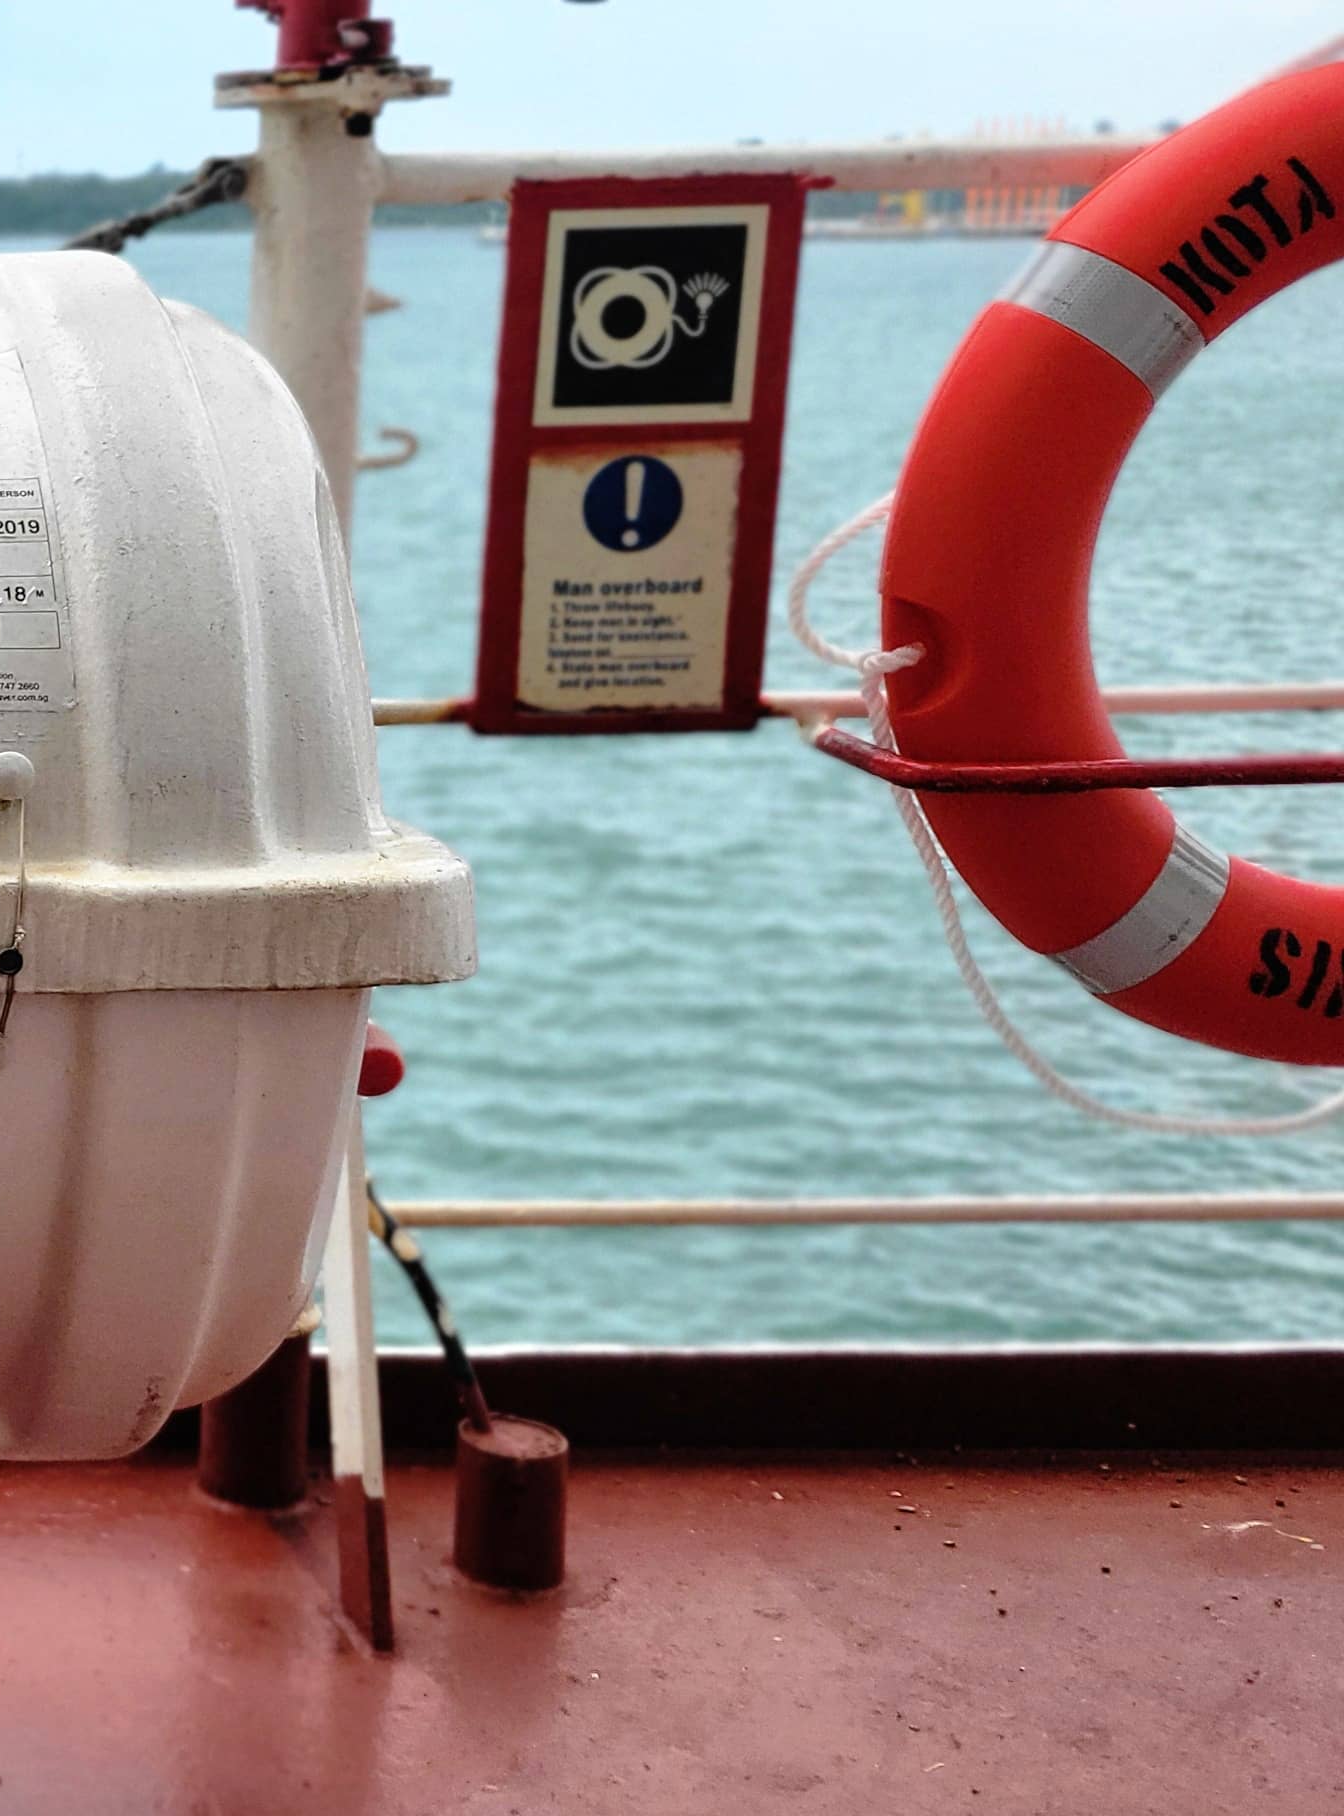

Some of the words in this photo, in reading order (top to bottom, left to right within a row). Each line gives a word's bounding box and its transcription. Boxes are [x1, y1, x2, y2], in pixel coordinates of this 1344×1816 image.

[1159, 156, 1335, 315] KOTA
[3, 586, 26, 601] 18
[553, 580, 593, 596] Man
[600, 577, 703, 595] overboard
[597, 632, 613, 641] for
[627, 661, 689, 671] overboard
